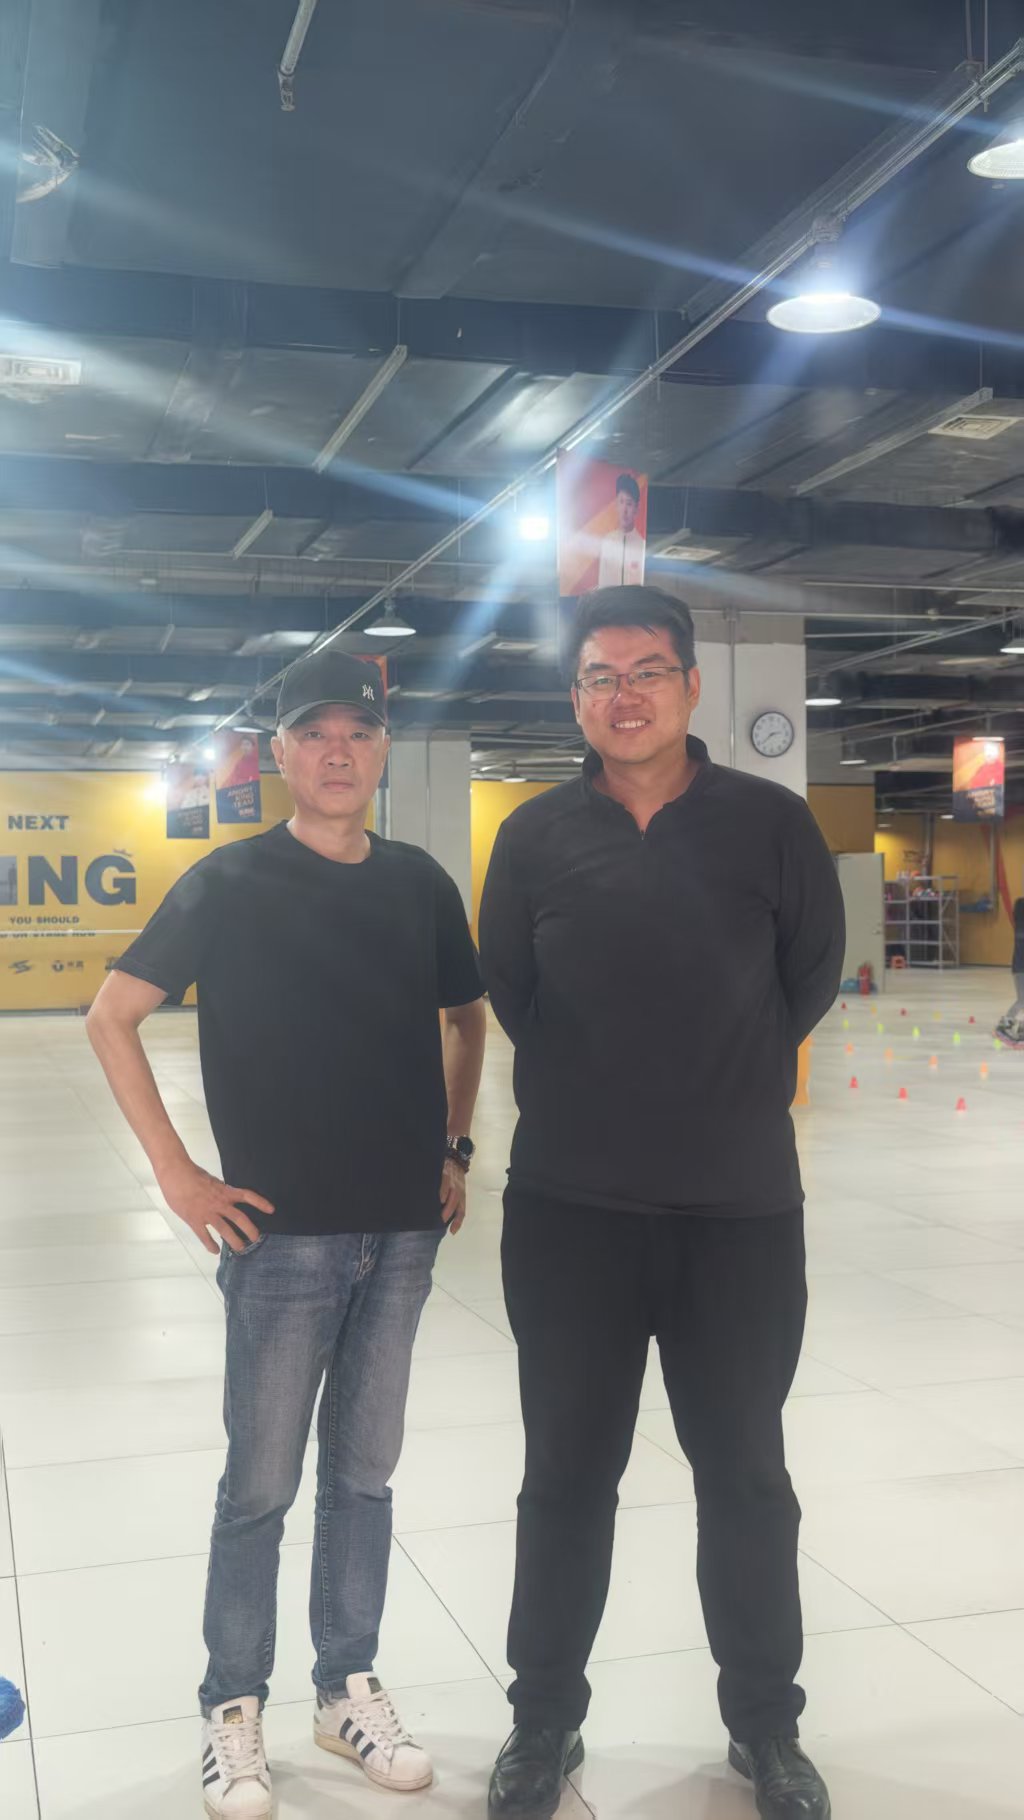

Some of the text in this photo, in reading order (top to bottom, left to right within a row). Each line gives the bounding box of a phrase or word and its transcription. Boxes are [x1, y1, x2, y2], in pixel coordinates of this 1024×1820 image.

[8, 815, 69, 831] NEXT
[9, 916, 80, 925] YOU SHOULD
